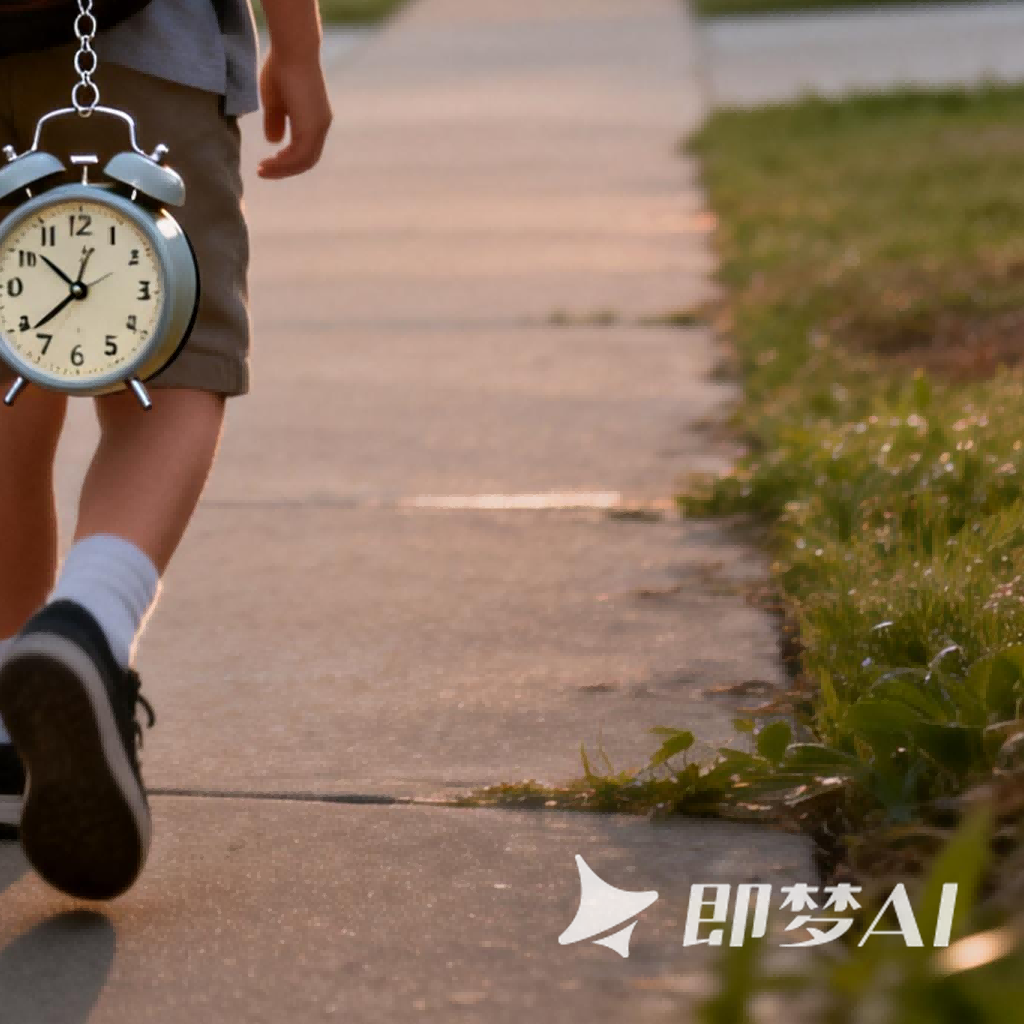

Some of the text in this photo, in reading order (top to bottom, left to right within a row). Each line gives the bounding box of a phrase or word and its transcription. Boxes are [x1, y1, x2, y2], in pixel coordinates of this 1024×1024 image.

[42, 226, 55, 246] 11
[69, 215, 92, 236] 12
[110, 226, 116, 245] 1
[36, 333, 53, 356] 7
[104, 335, 118, 356] 5
[70, 345, 84, 366] 6
